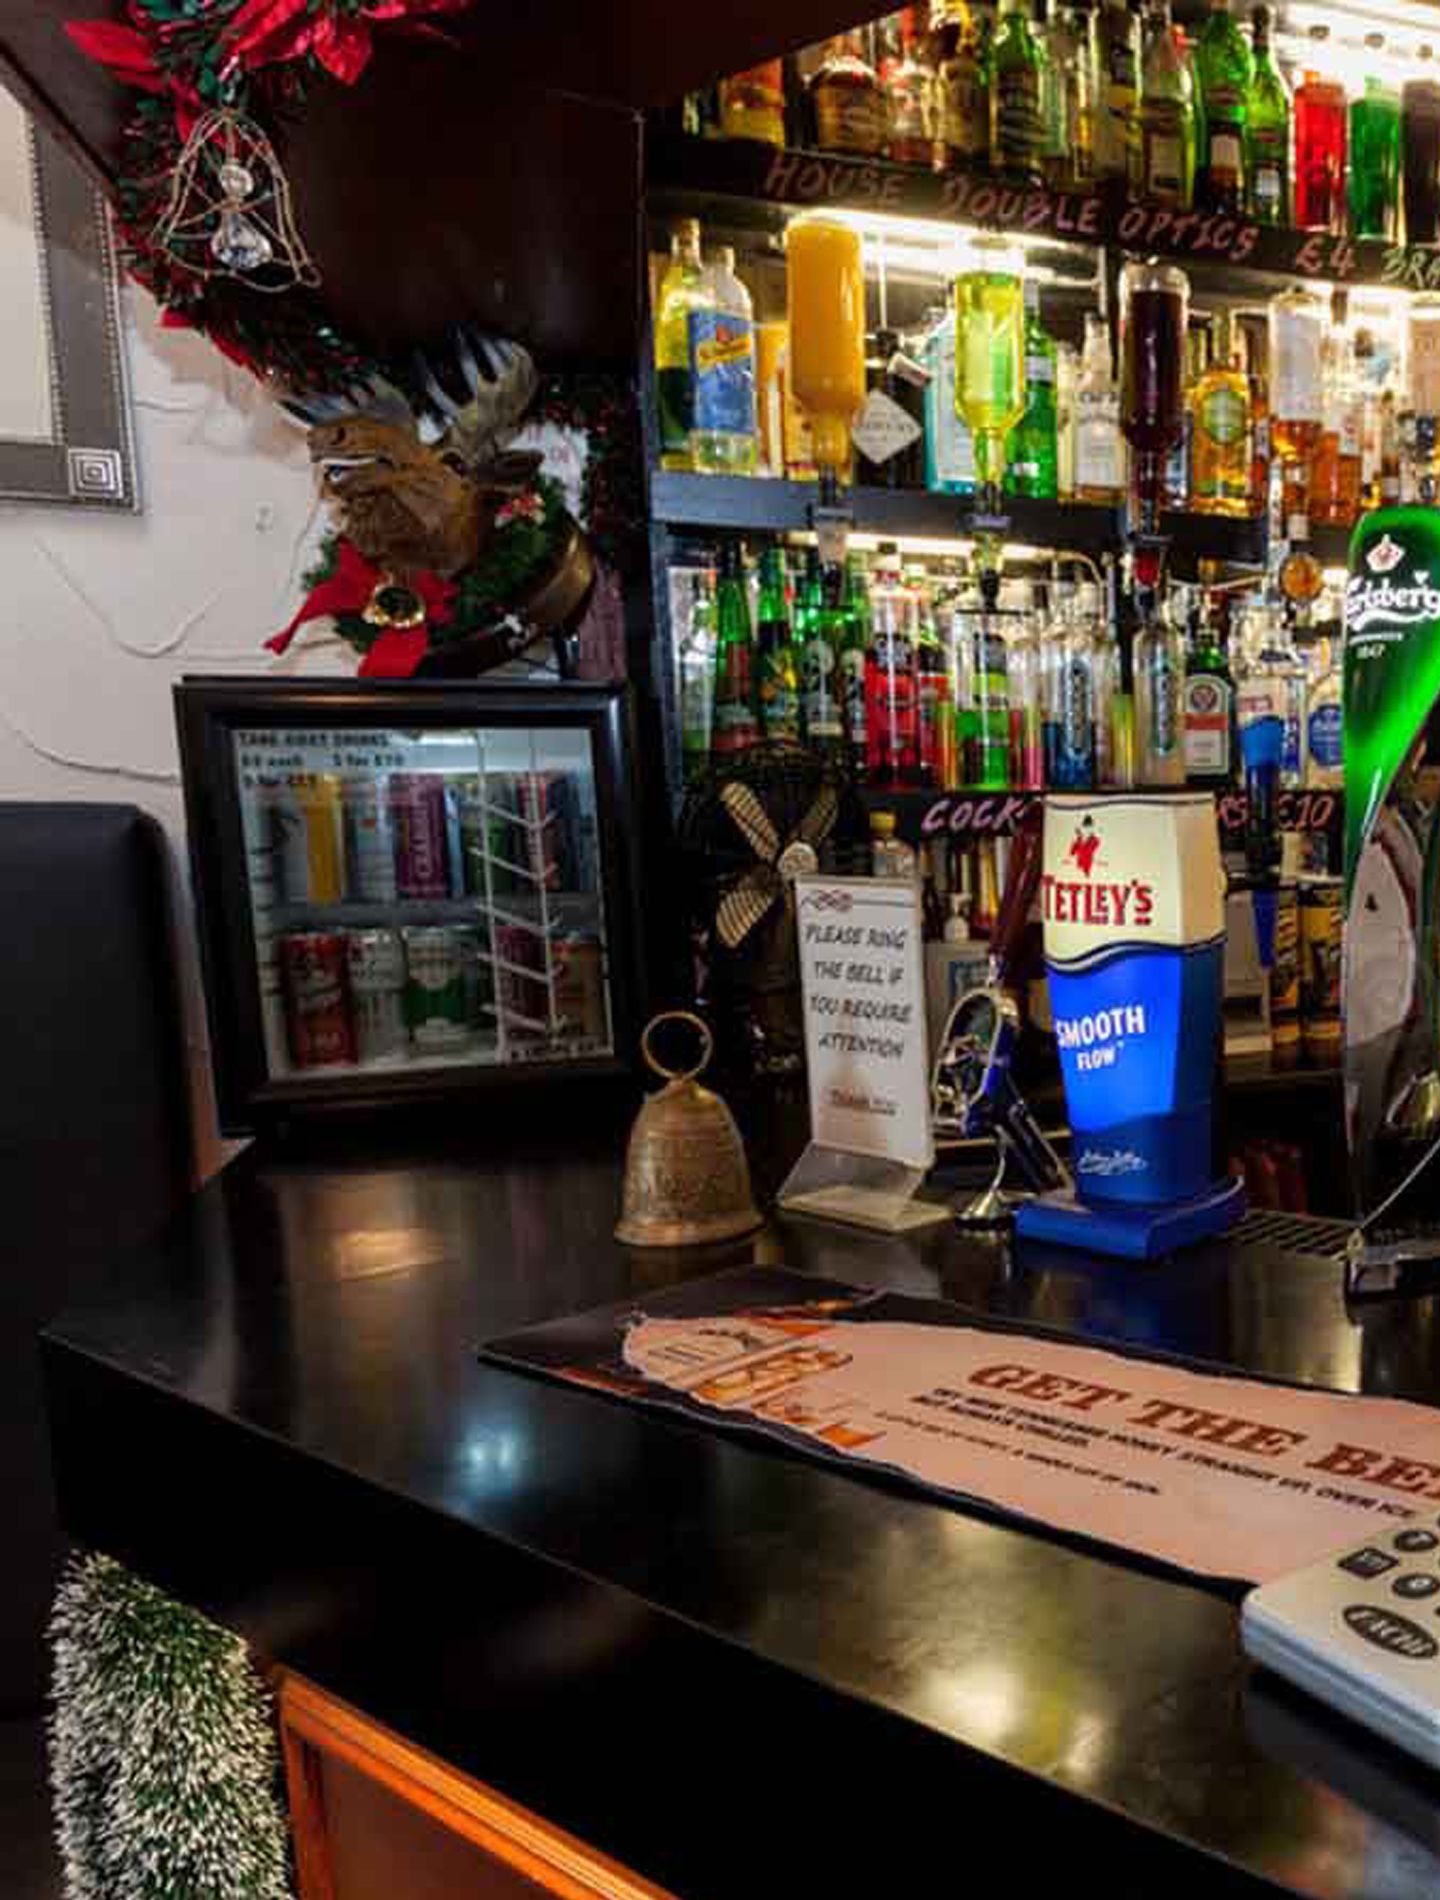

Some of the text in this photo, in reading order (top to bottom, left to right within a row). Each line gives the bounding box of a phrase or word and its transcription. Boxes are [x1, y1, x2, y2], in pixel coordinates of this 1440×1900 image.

[1117, 205, 1261, 262] OPTICS
[1041, 875, 1153, 926] TETLEY'S
[806, 923, 908, 948] PLEASE RING
[813, 960, 904, 984] THE BELL IF
[810, 996, 914, 1025] YOU REQUIRE
[1056, 1003, 1147, 1049] SMOOTH
[818, 1031, 904, 1058] ATTENTION
[1076, 1047, 1117, 1071] FLOW
[967, 1361, 1132, 1412] GET
[1125, 1399, 1308, 1458] THE
